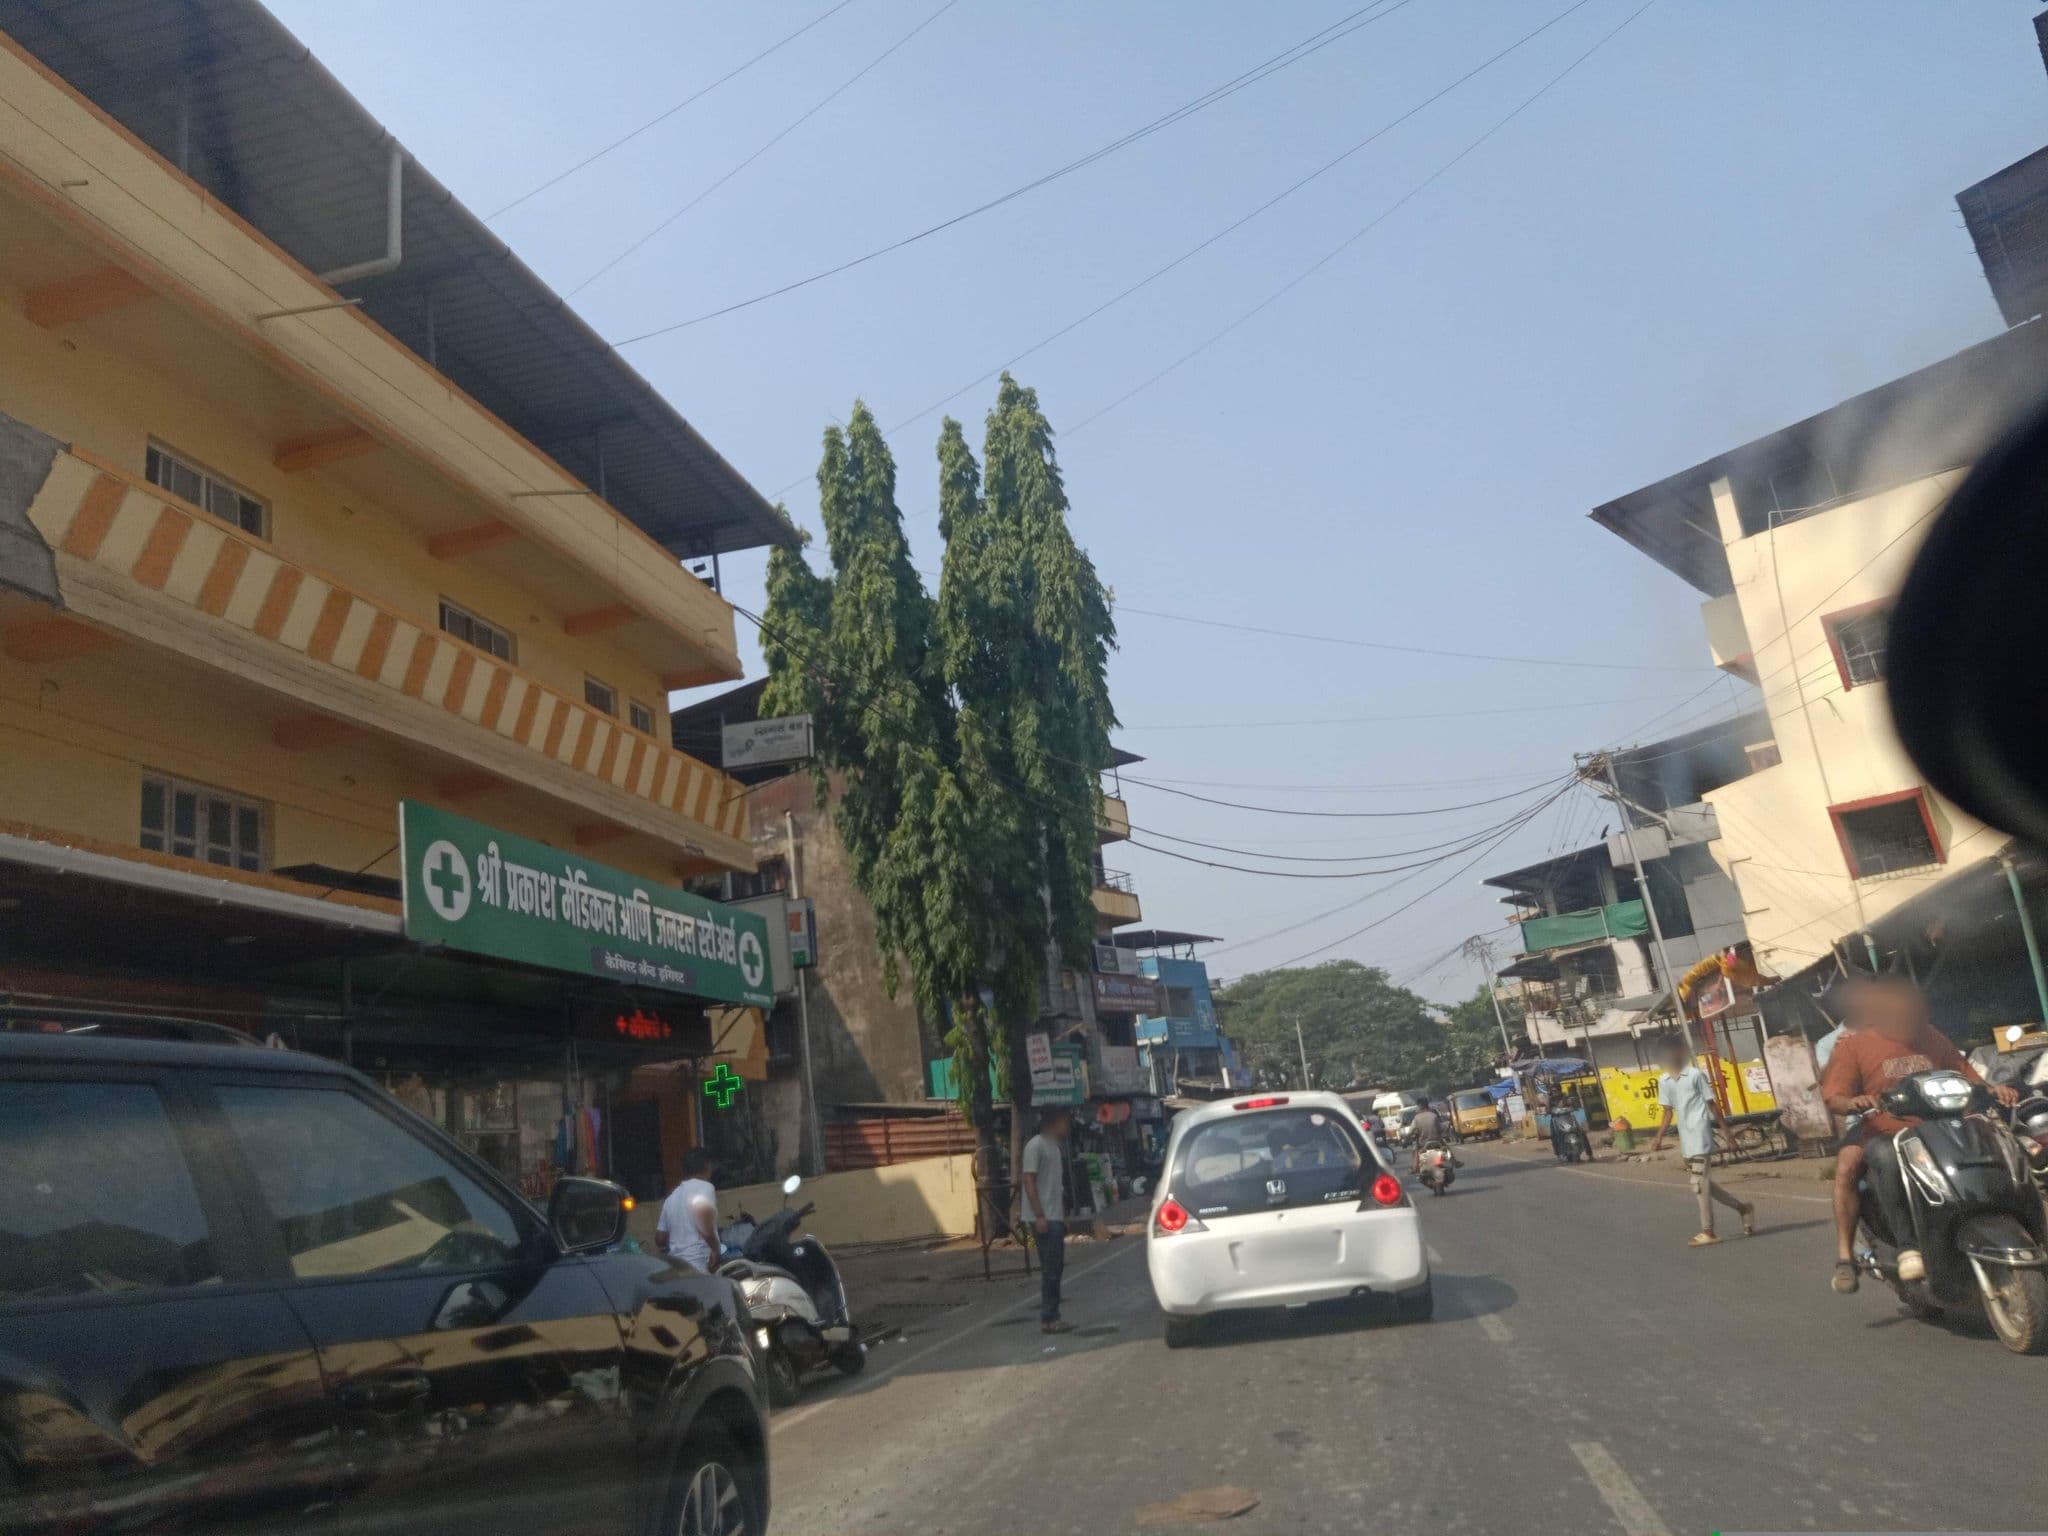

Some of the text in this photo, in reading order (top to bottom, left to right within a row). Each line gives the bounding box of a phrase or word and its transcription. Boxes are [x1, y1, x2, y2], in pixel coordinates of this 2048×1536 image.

[477, 841, 737, 965] श्री प्रकाश मेडिकल आणि जनरल स्टोअर्स
